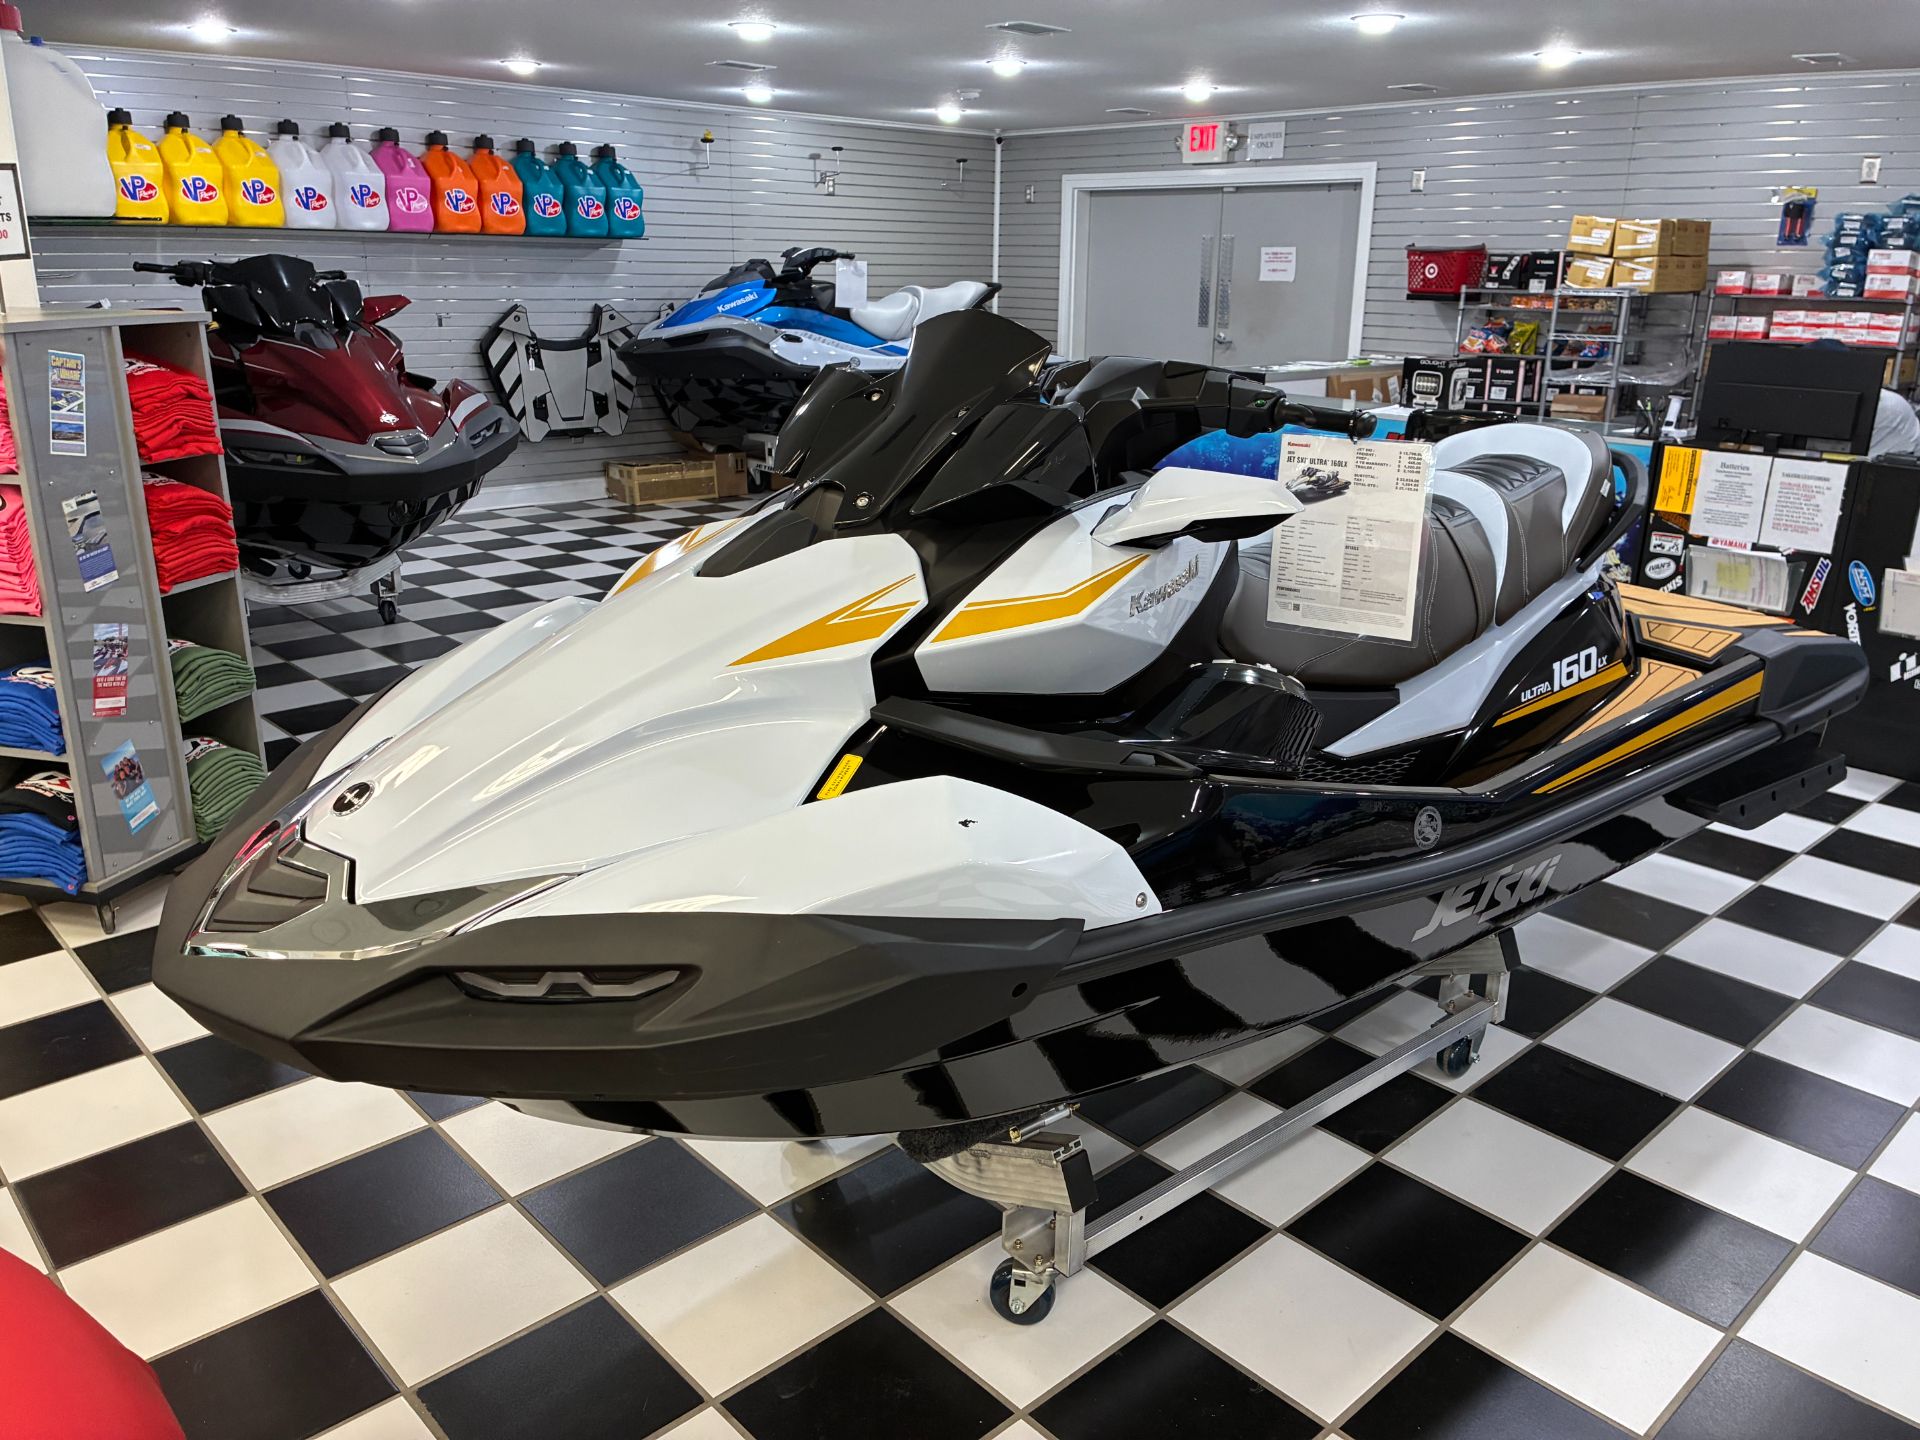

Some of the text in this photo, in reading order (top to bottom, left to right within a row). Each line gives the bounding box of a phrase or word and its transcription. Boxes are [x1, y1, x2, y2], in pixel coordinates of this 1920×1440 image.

[1190, 125, 1219, 152] EXIT
[1250, 132, 1282, 140] EMPLOYEES
[1256, 140, 1274, 148] ONLY
[120, 175, 145, 201] VP
[182, 176, 206, 202] VP
[242, 179, 264, 204] VP
[295, 186, 316, 211] VP
[351, 184, 371, 209] VP
[397, 188, 419, 212] VP
[446, 189, 466, 213] VP
[492, 193, 511, 216] VP
[534, 194, 553, 218] VP
[578, 196, 596, 219] VP
[615, 197, 633, 220] VP
[716, 292, 758, 314] Kawasaki
[1720, 461, 1749, 471] Batteries
[1720, 538, 1748, 550] YAMAHA
[1648, 561, 1672, 572] IVAN'S
[1129, 554, 1199, 618] Kawasaki
[1802, 558, 1831, 613] AMSOIL
[1521, 646, 1608, 702] ULTRA 160 LX
